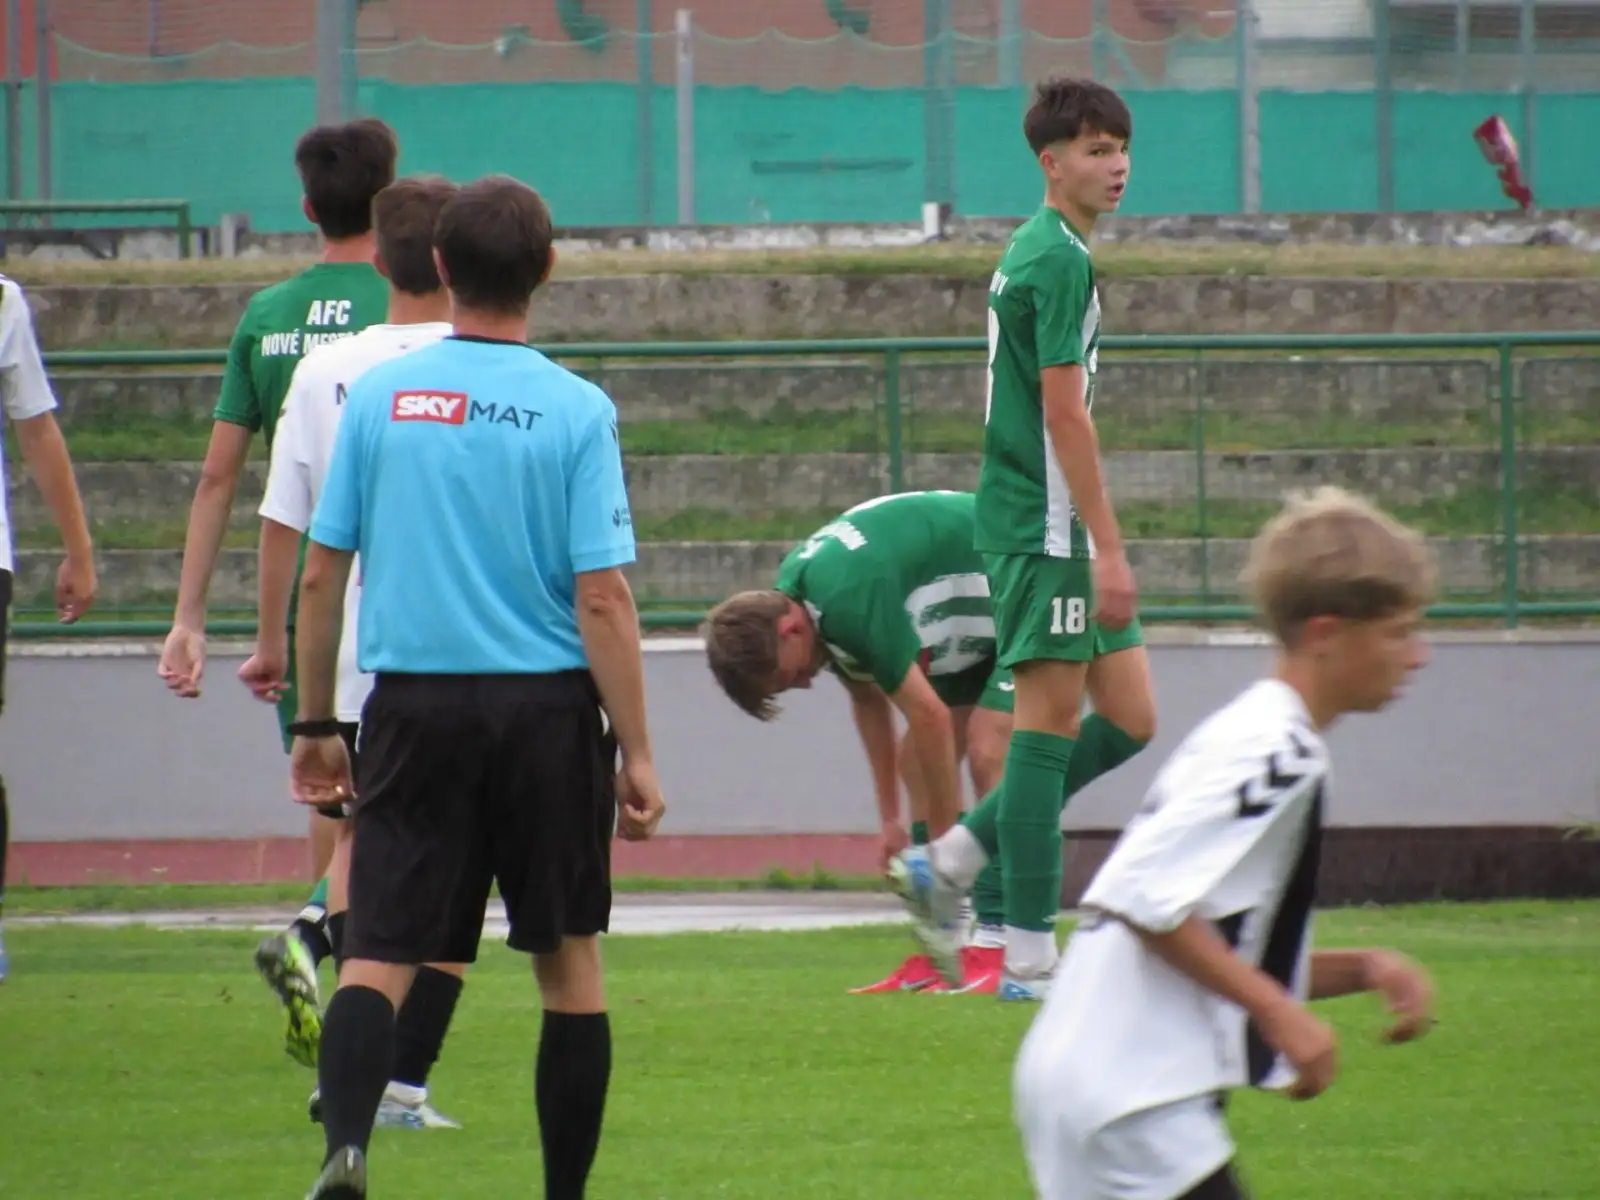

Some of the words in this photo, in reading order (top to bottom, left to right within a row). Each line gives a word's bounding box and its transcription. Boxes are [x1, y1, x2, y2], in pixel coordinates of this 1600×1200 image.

[306, 300, 352, 325] AFC
[261, 328, 299, 357] NOVÉ
[395, 394, 461, 418] SKY
[468, 399, 543, 431] MAT
[1050, 597, 1086, 634] 18
